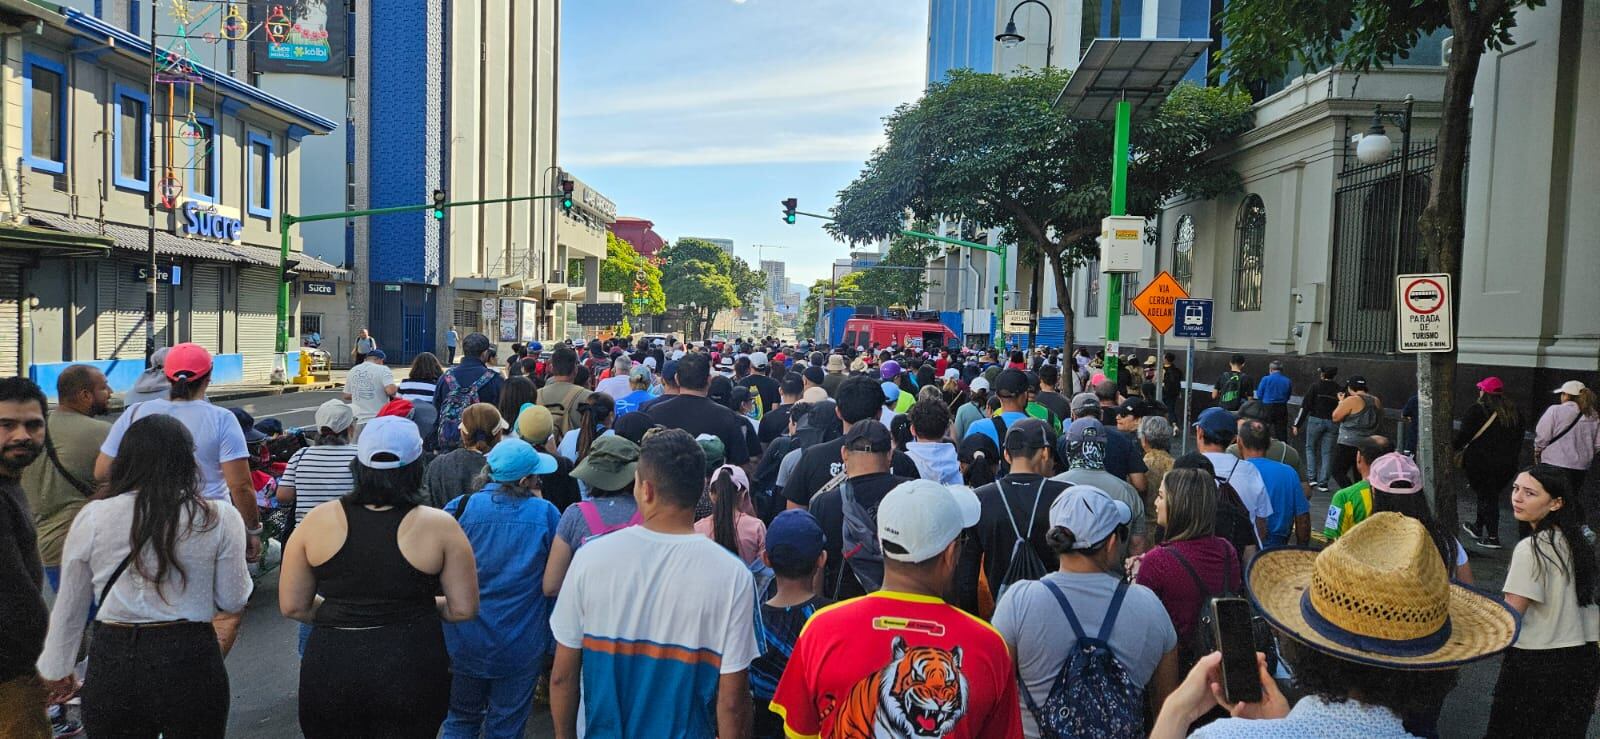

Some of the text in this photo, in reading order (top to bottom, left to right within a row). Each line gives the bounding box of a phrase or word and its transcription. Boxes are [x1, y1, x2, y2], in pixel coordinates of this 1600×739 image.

[183, 201, 243, 241] Sucre
[138, 268, 169, 280] Sre
[308, 283, 332, 293] Sucre
[1159, 284, 1170, 293] VIA
[1147, 307, 1175, 317] ADELAN
[1410, 314, 1440, 323] PARADA
[1420, 323, 1430, 331] DE
[1412, 332, 1439, 340] TURISMO
